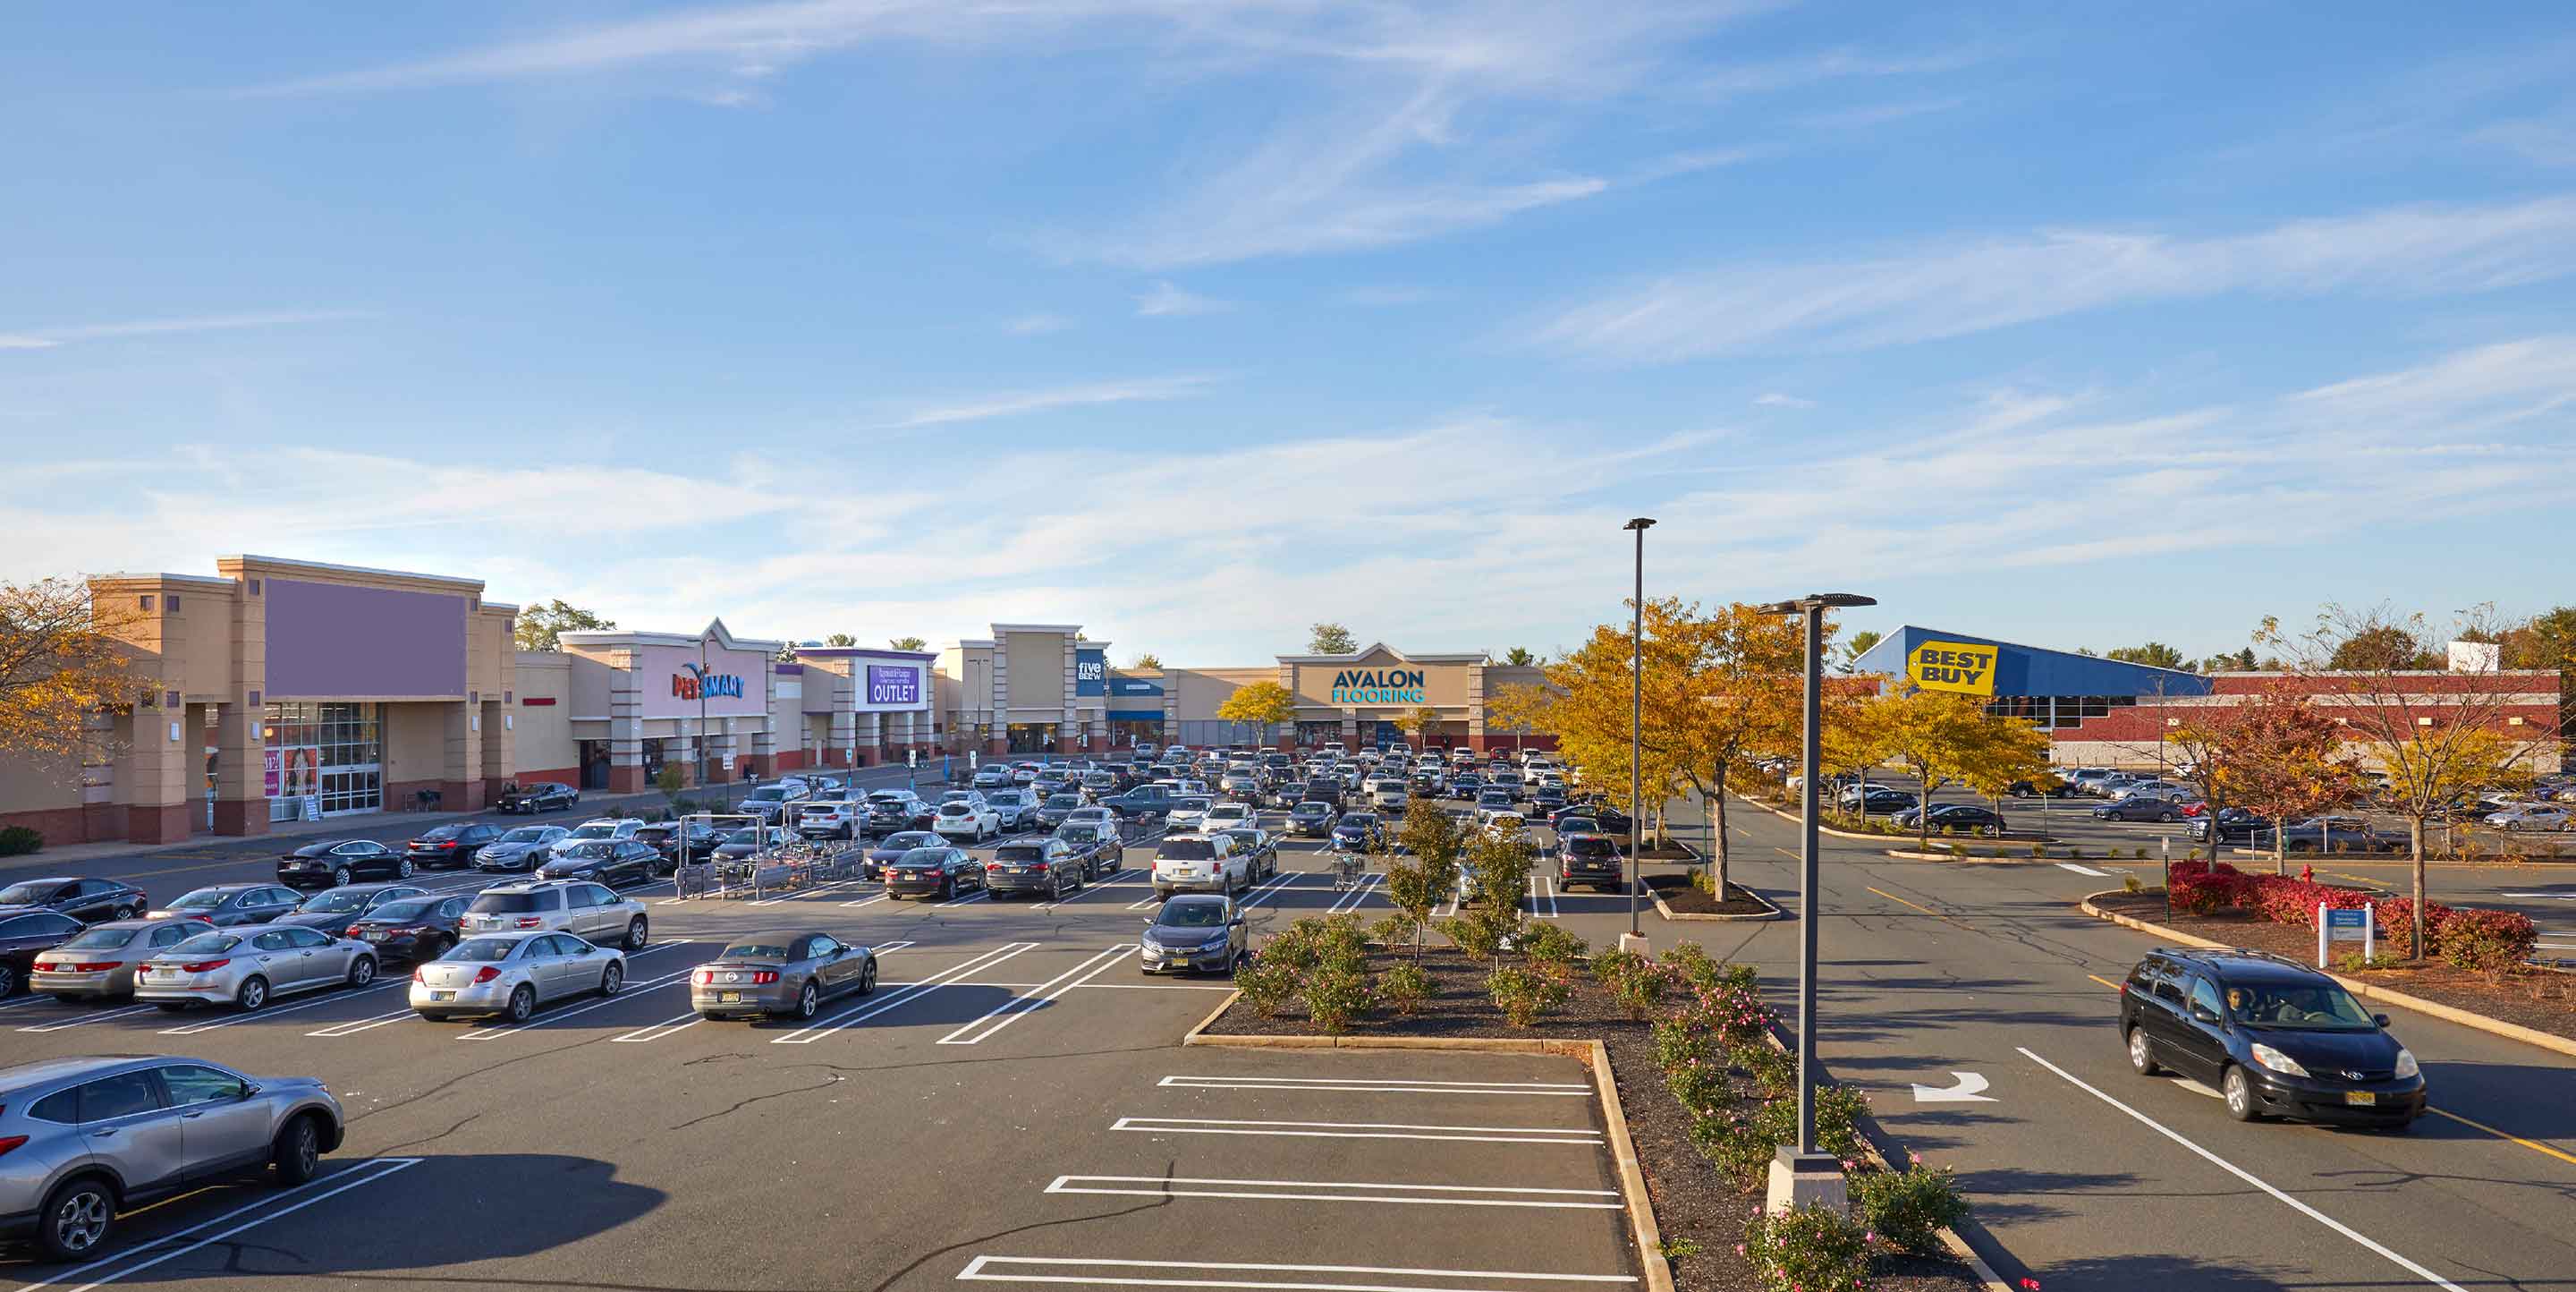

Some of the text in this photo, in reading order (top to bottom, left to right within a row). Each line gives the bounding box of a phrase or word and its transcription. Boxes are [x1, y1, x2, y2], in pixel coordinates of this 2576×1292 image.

[1079, 662, 1101, 673] five
[1920, 649, 1993, 669] BEST
[1332, 669, 1425, 687] AVALON
[1920, 667, 1984, 685] BUY
[874, 684, 915, 702] OUTLET
[1332, 688, 1425, 702] FLOORING
